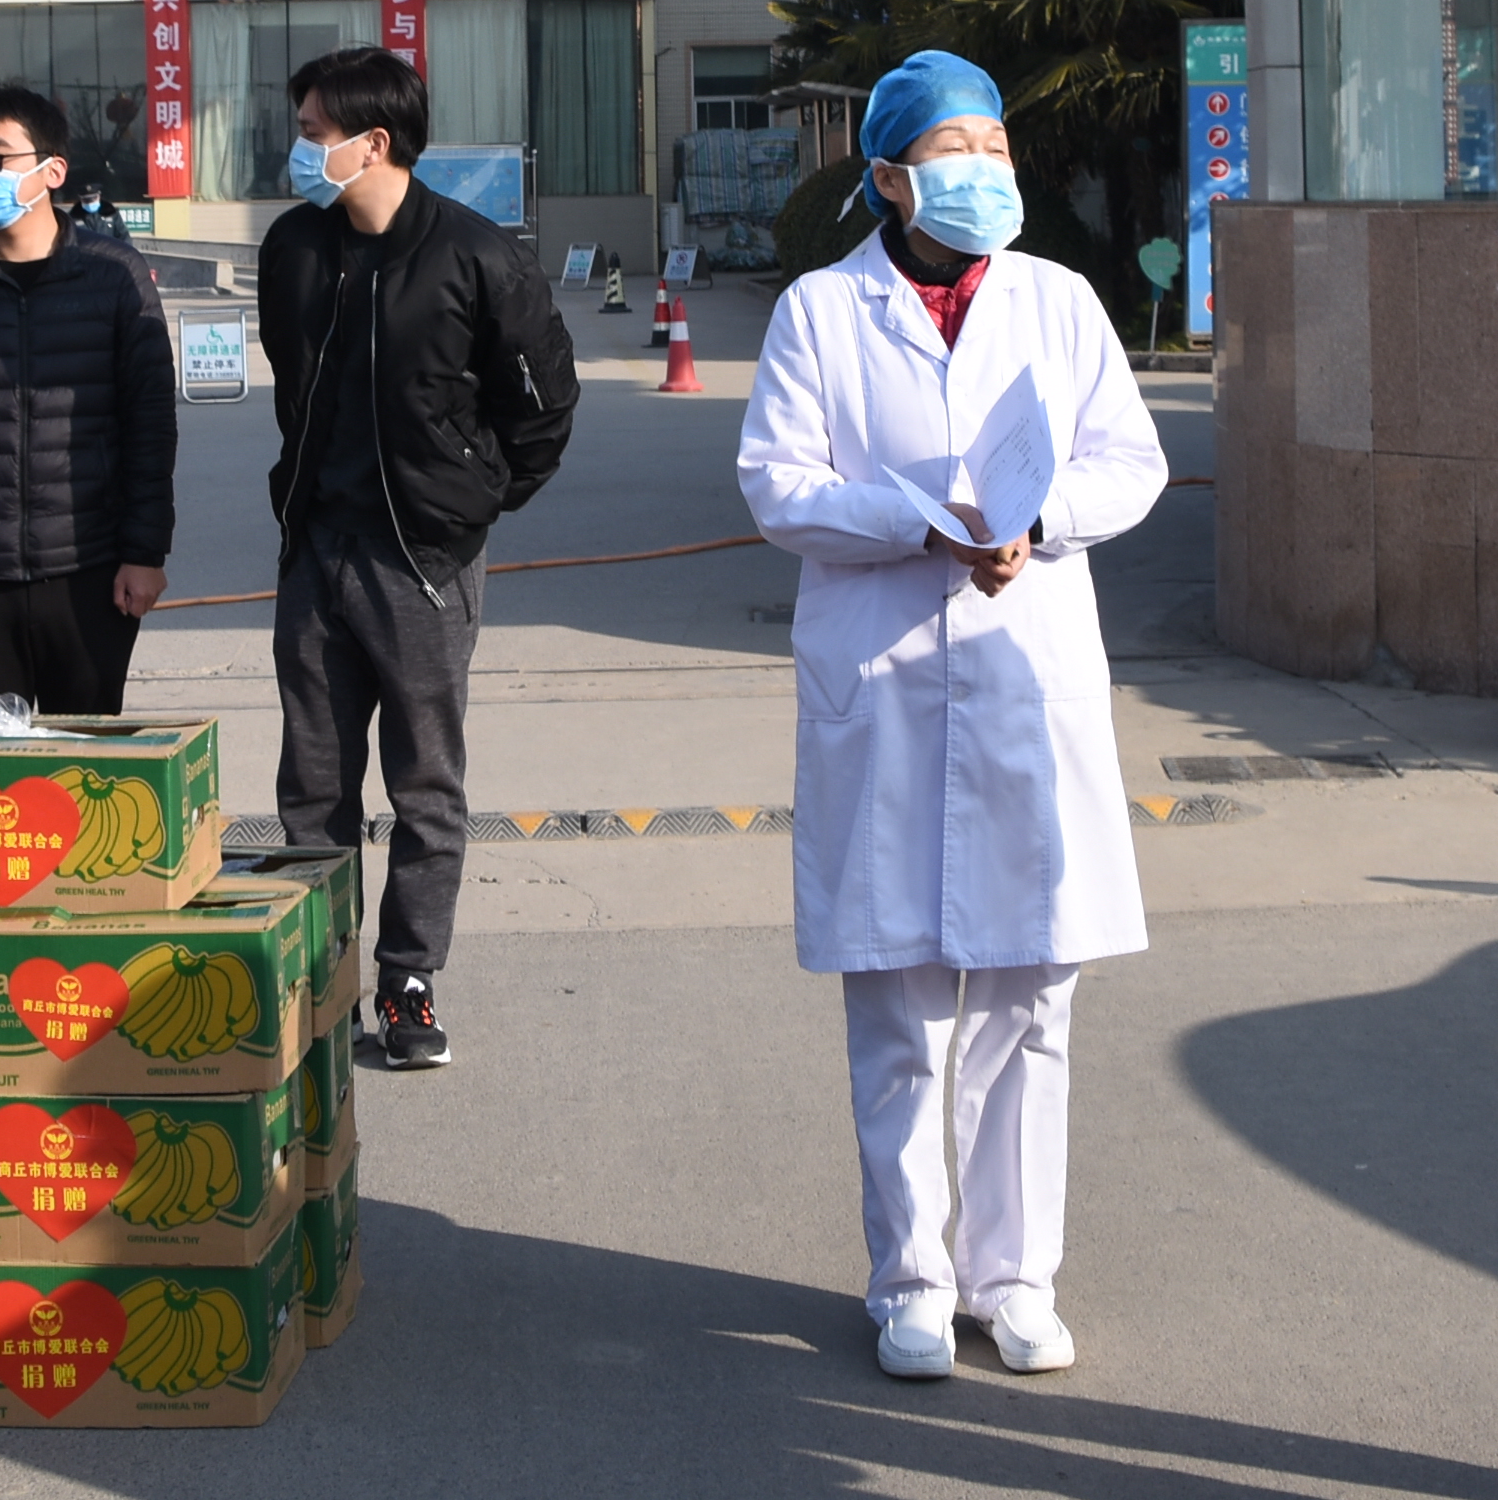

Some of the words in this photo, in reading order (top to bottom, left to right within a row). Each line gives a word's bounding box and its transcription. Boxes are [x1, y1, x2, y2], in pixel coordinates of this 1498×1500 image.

[188, 344, 240, 356] 无障碍通道
[192, 359, 236, 370] 禁止停车
[55, 886, 82, 895] GREEN
[22, 998, 114, 1020] 商丘市博爱联合会
[46, 1019, 88, 1042] 捐赠
[146, 1067, 176, 1076] GREEN
[33, 1186, 86, 1212] 捐赠
[127, 1235, 156, 1244] GREEN
[21, 1364, 76, 1389] 捐赠
[136, 1401, 166, 1410] GREEN
